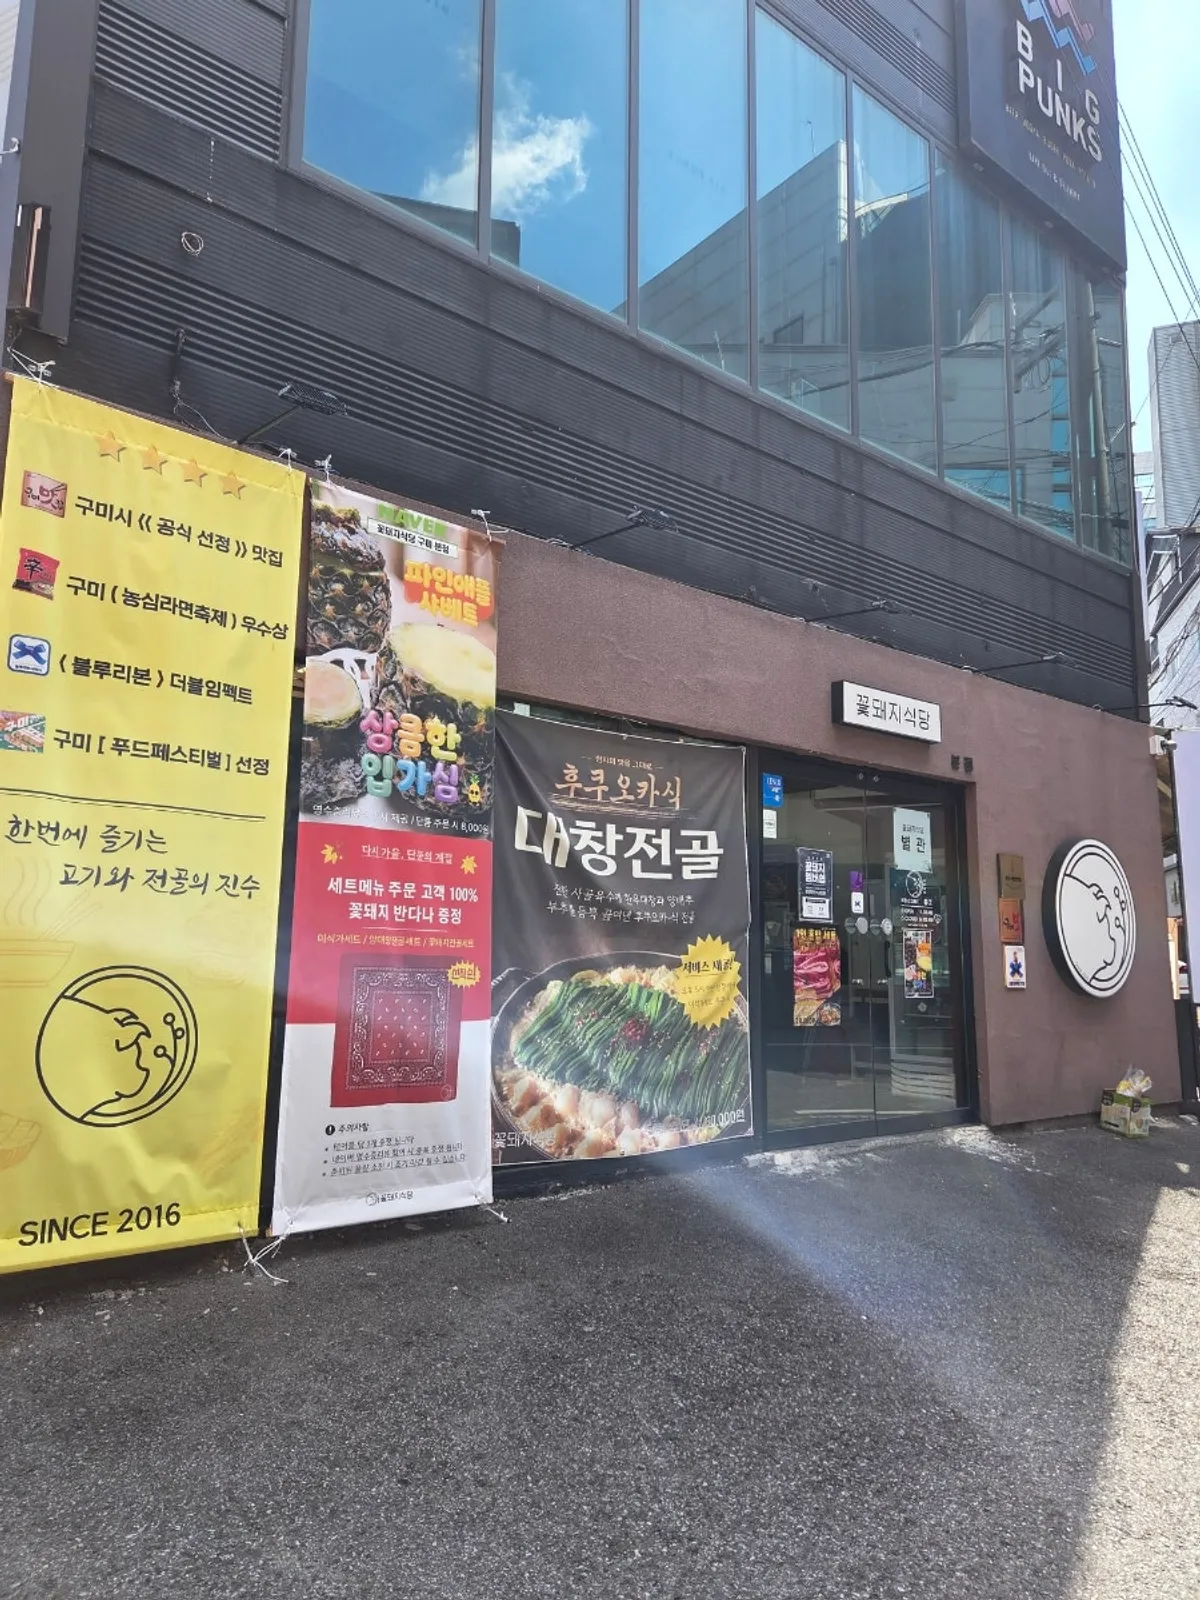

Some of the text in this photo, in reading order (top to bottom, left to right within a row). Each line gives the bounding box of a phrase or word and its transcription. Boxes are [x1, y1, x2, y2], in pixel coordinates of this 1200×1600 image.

[1018, 58, 1103, 163] PUNKS
[75, 496, 132, 528] 구미시
[157, 518, 192, 542] 공식
[197, 531, 230, 554] 선정
[252, 545, 283, 568] 맛집
[404, 560, 492, 607] 파인애플
[66, 576, 105, 601] 구미
[241, 616, 289, 640] 우수상
[360, 710, 461, 761] 상큼한
[856, 693, 930, 731] 꽃돼지식당
[53, 729, 91, 751] 구미
[236, 756, 270, 776] 선정
[362, 753, 459, 804] 입가심
[555, 762, 682, 811] 후쿠오카식
[5, 814, 168, 854] 한번에 즐기는
[514, 805, 724, 881] 대창전골
[59, 864, 261, 899] 고기와 전골의 진수
[327, 877, 479, 903] 세트메뉴 주문 고객 100%
[348, 902, 462, 925] 꽃돼지 반다나 증정
[683, 961, 710, 974] 서비스
[18, 1202, 181, 1247] SINCE 2016
